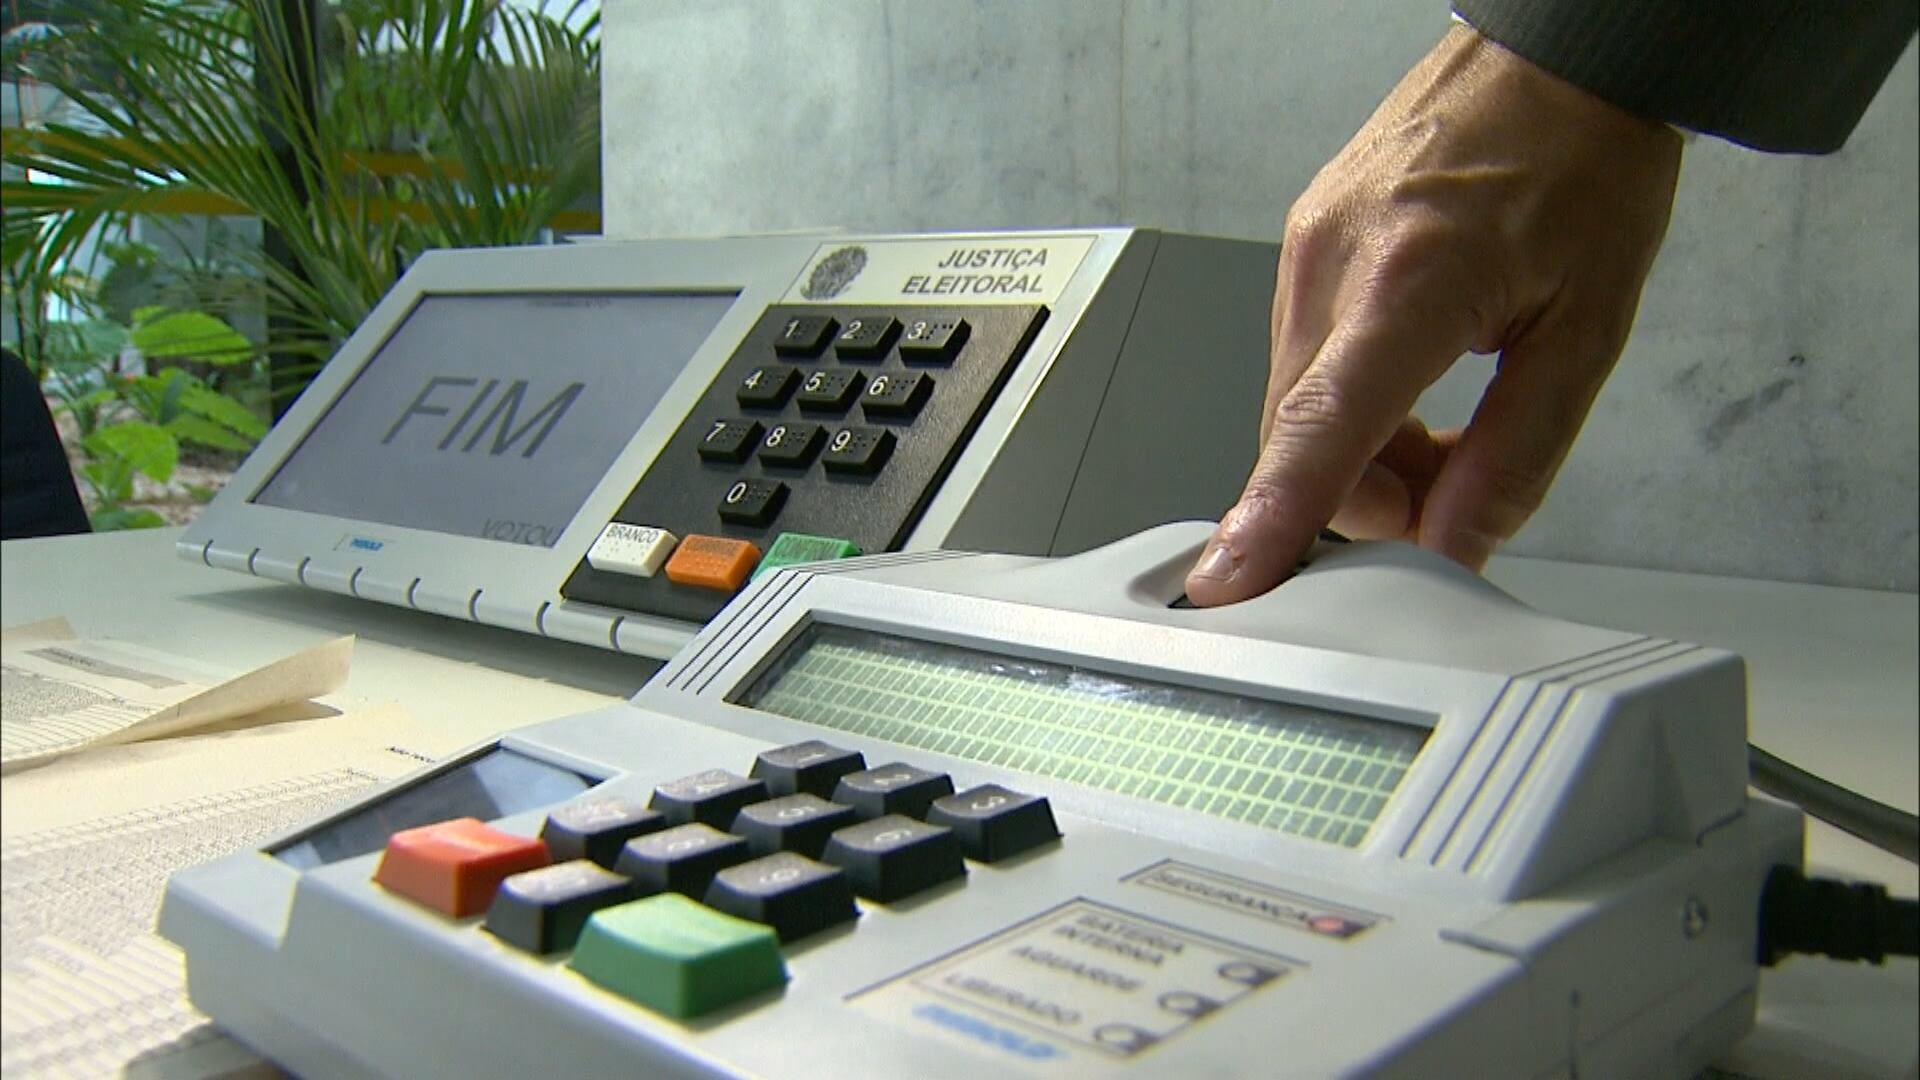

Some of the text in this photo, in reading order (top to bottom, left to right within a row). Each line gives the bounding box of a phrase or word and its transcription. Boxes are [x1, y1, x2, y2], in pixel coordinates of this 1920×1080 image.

[938, 248, 1048, 271] JUSTIÇA
[901, 274, 1043, 294] ELEITORAL
[784, 320, 927, 340] 1 2 3
[744, 369, 889, 396] 4 5 6
[380, 375, 586, 459] FIM
[705, 422, 851, 452] 7 8 9
[726, 481, 748, 504] 0
[606, 524, 659, 544] BRANCO
